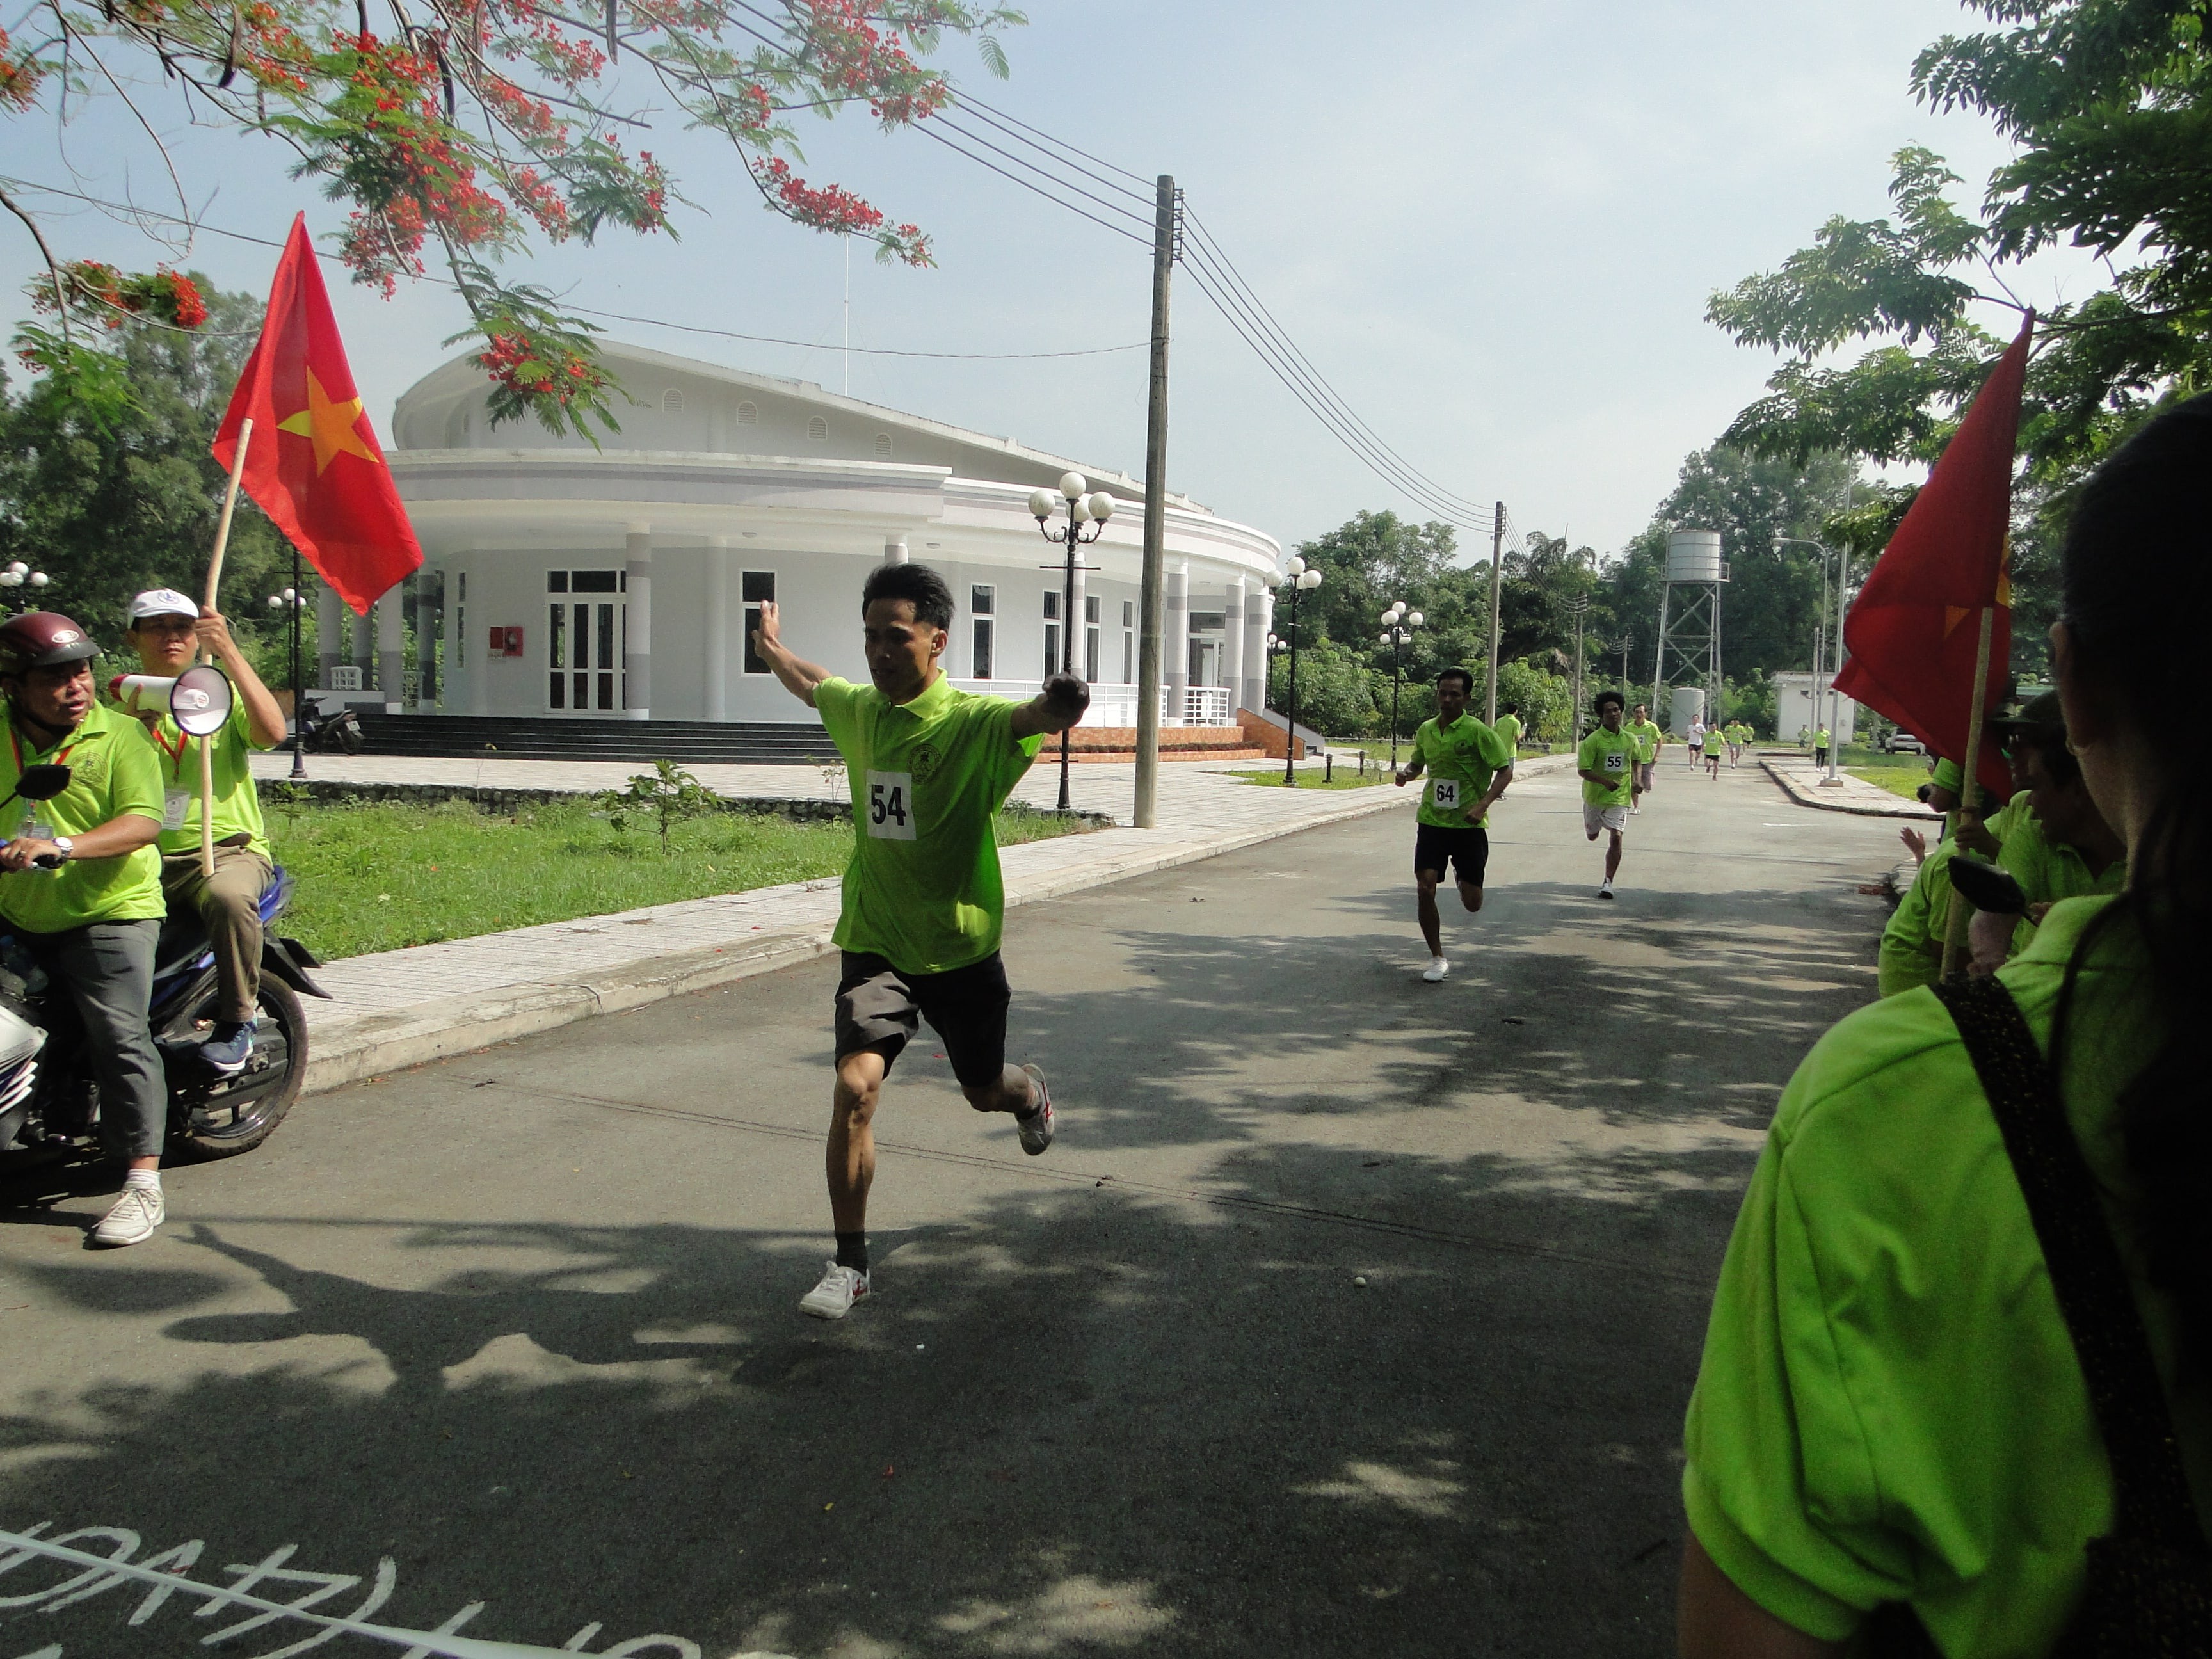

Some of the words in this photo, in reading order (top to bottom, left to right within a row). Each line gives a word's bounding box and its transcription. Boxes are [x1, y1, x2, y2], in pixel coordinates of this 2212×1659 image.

[1607, 756, 1622, 767] 55
[1436, 785, 1455, 802] 64
[871, 784, 906, 826] 54
